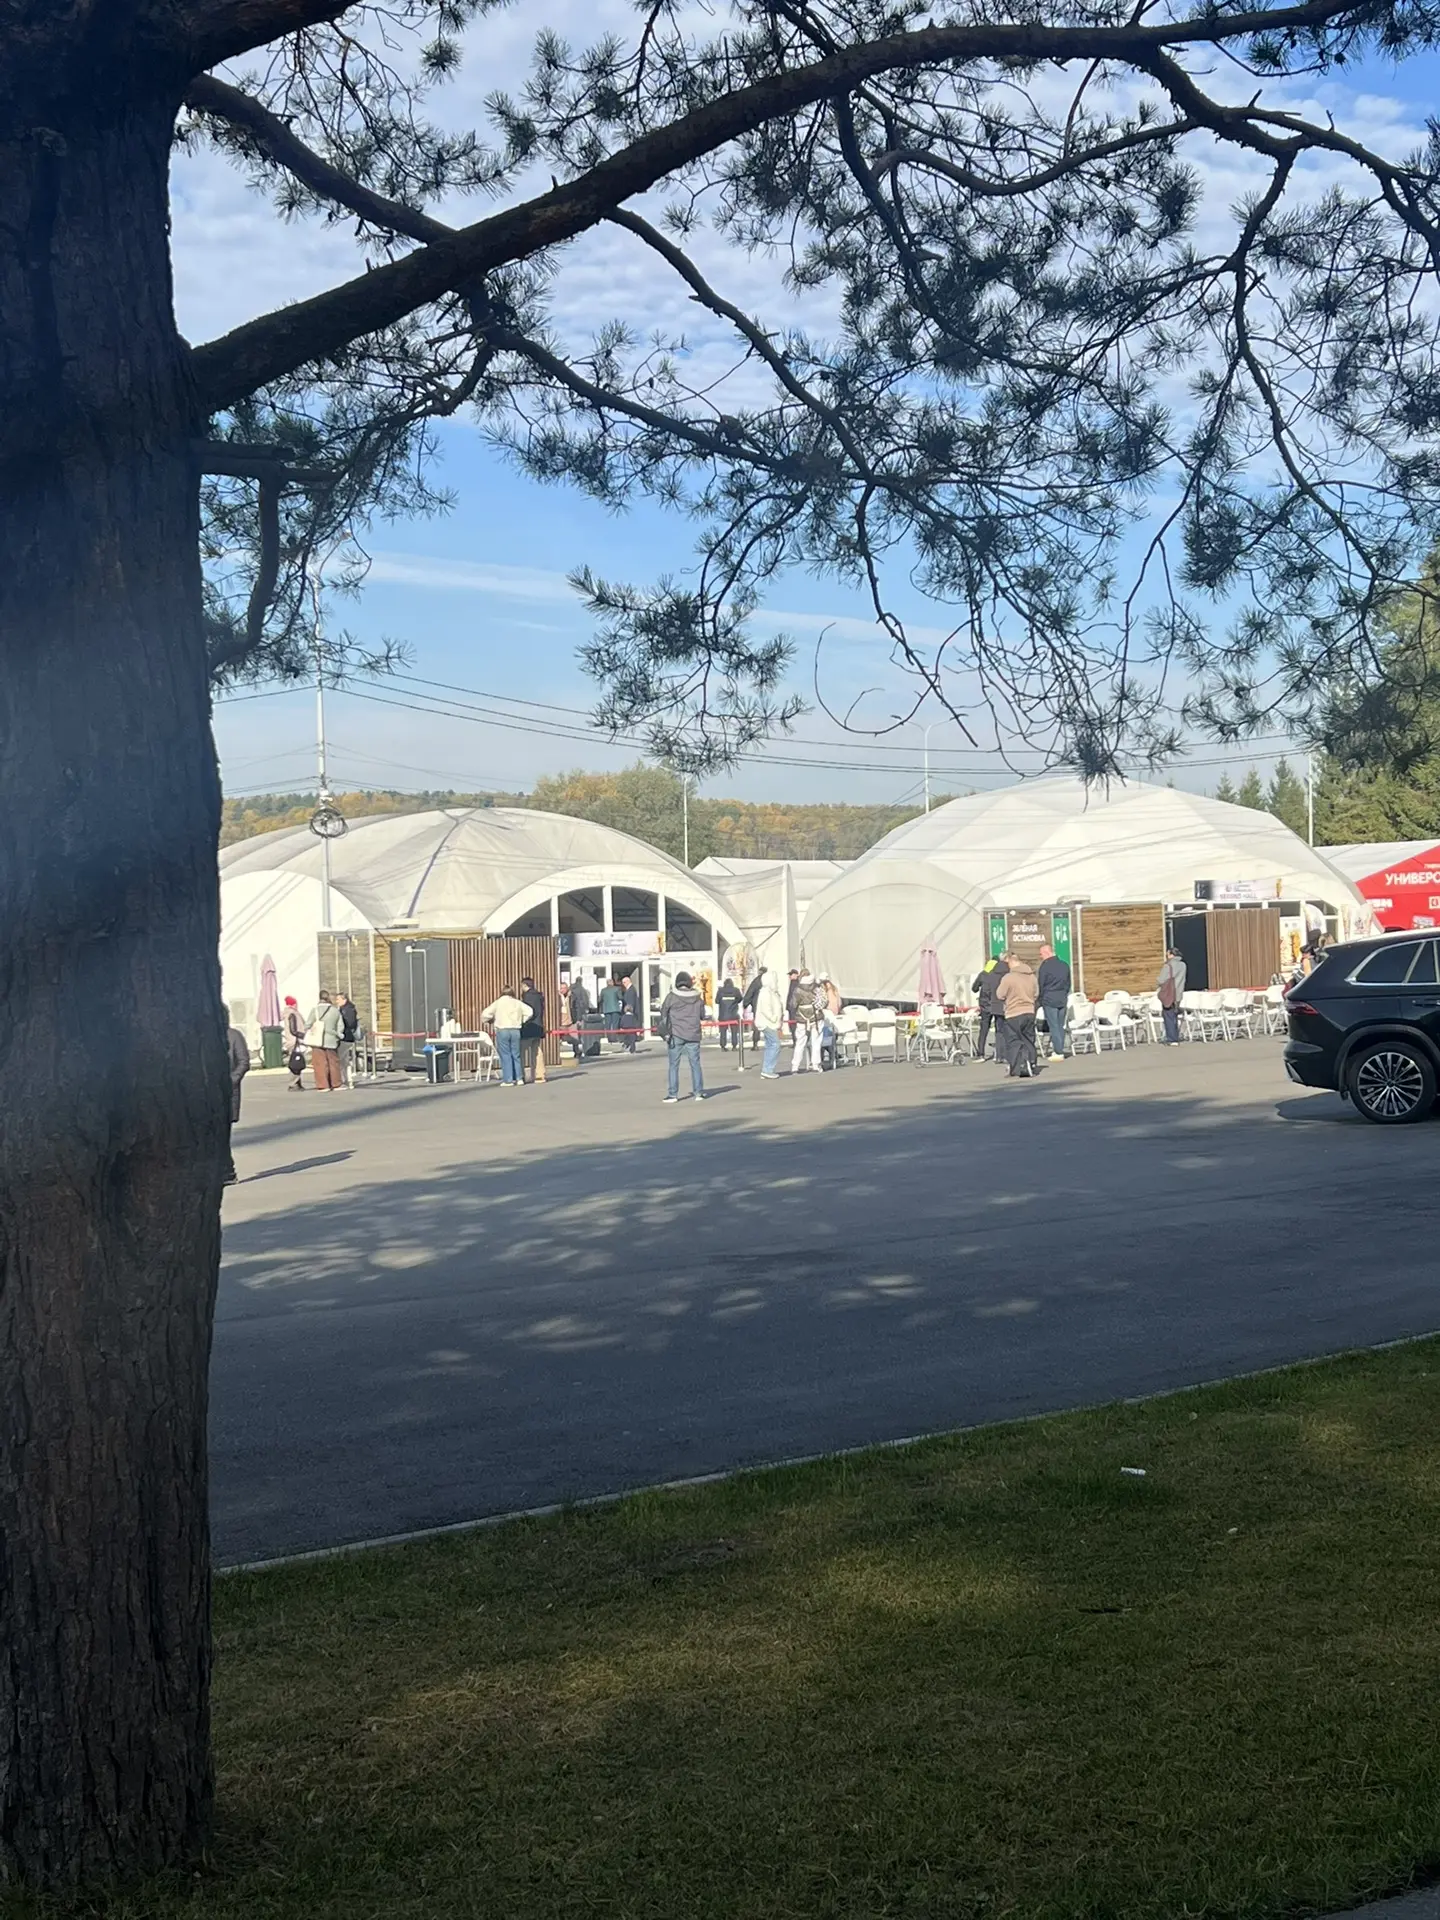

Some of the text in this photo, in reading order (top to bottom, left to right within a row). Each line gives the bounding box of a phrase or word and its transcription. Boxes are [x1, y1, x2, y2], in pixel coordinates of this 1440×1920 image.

[1384, 871, 1440, 886] УНИВЕРС
[592, 948, 628, 956] MAIN HALL
